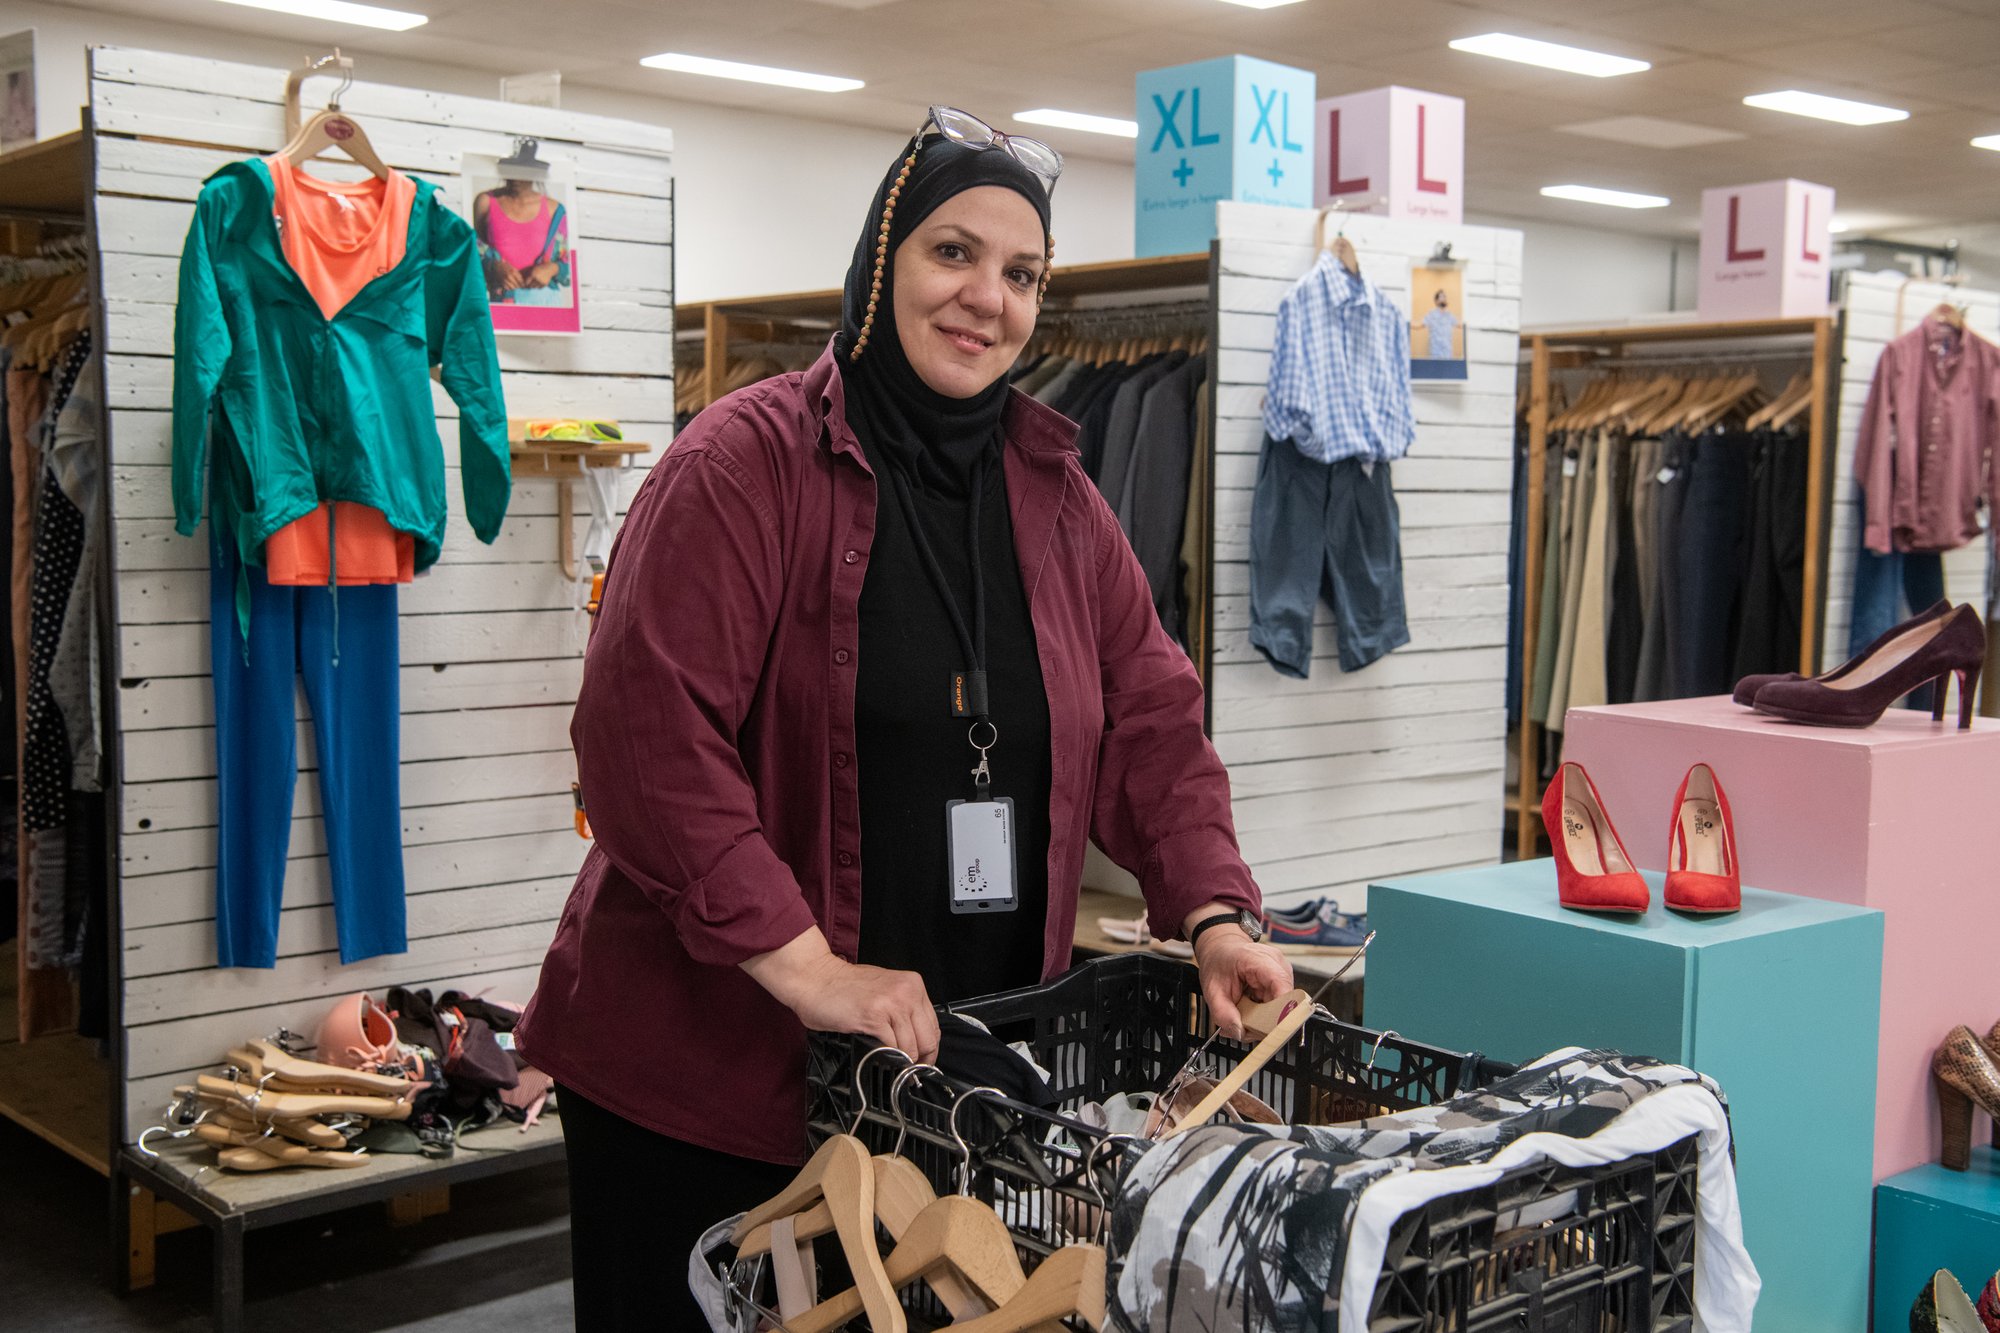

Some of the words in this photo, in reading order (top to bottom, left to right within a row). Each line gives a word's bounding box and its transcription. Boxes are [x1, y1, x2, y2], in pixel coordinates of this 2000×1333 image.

[1151, 87, 1220, 153] XL
[1250, 84, 1303, 153] XL
[1329, 108, 1370, 196] L
[1417, 104, 1448, 195] L
[1727, 195, 1766, 262] L
[1803, 194, 1820, 262] L
[955, 676, 963, 712] Orange
[995, 808, 1002, 818] 65
[968, 866, 976, 883] em
